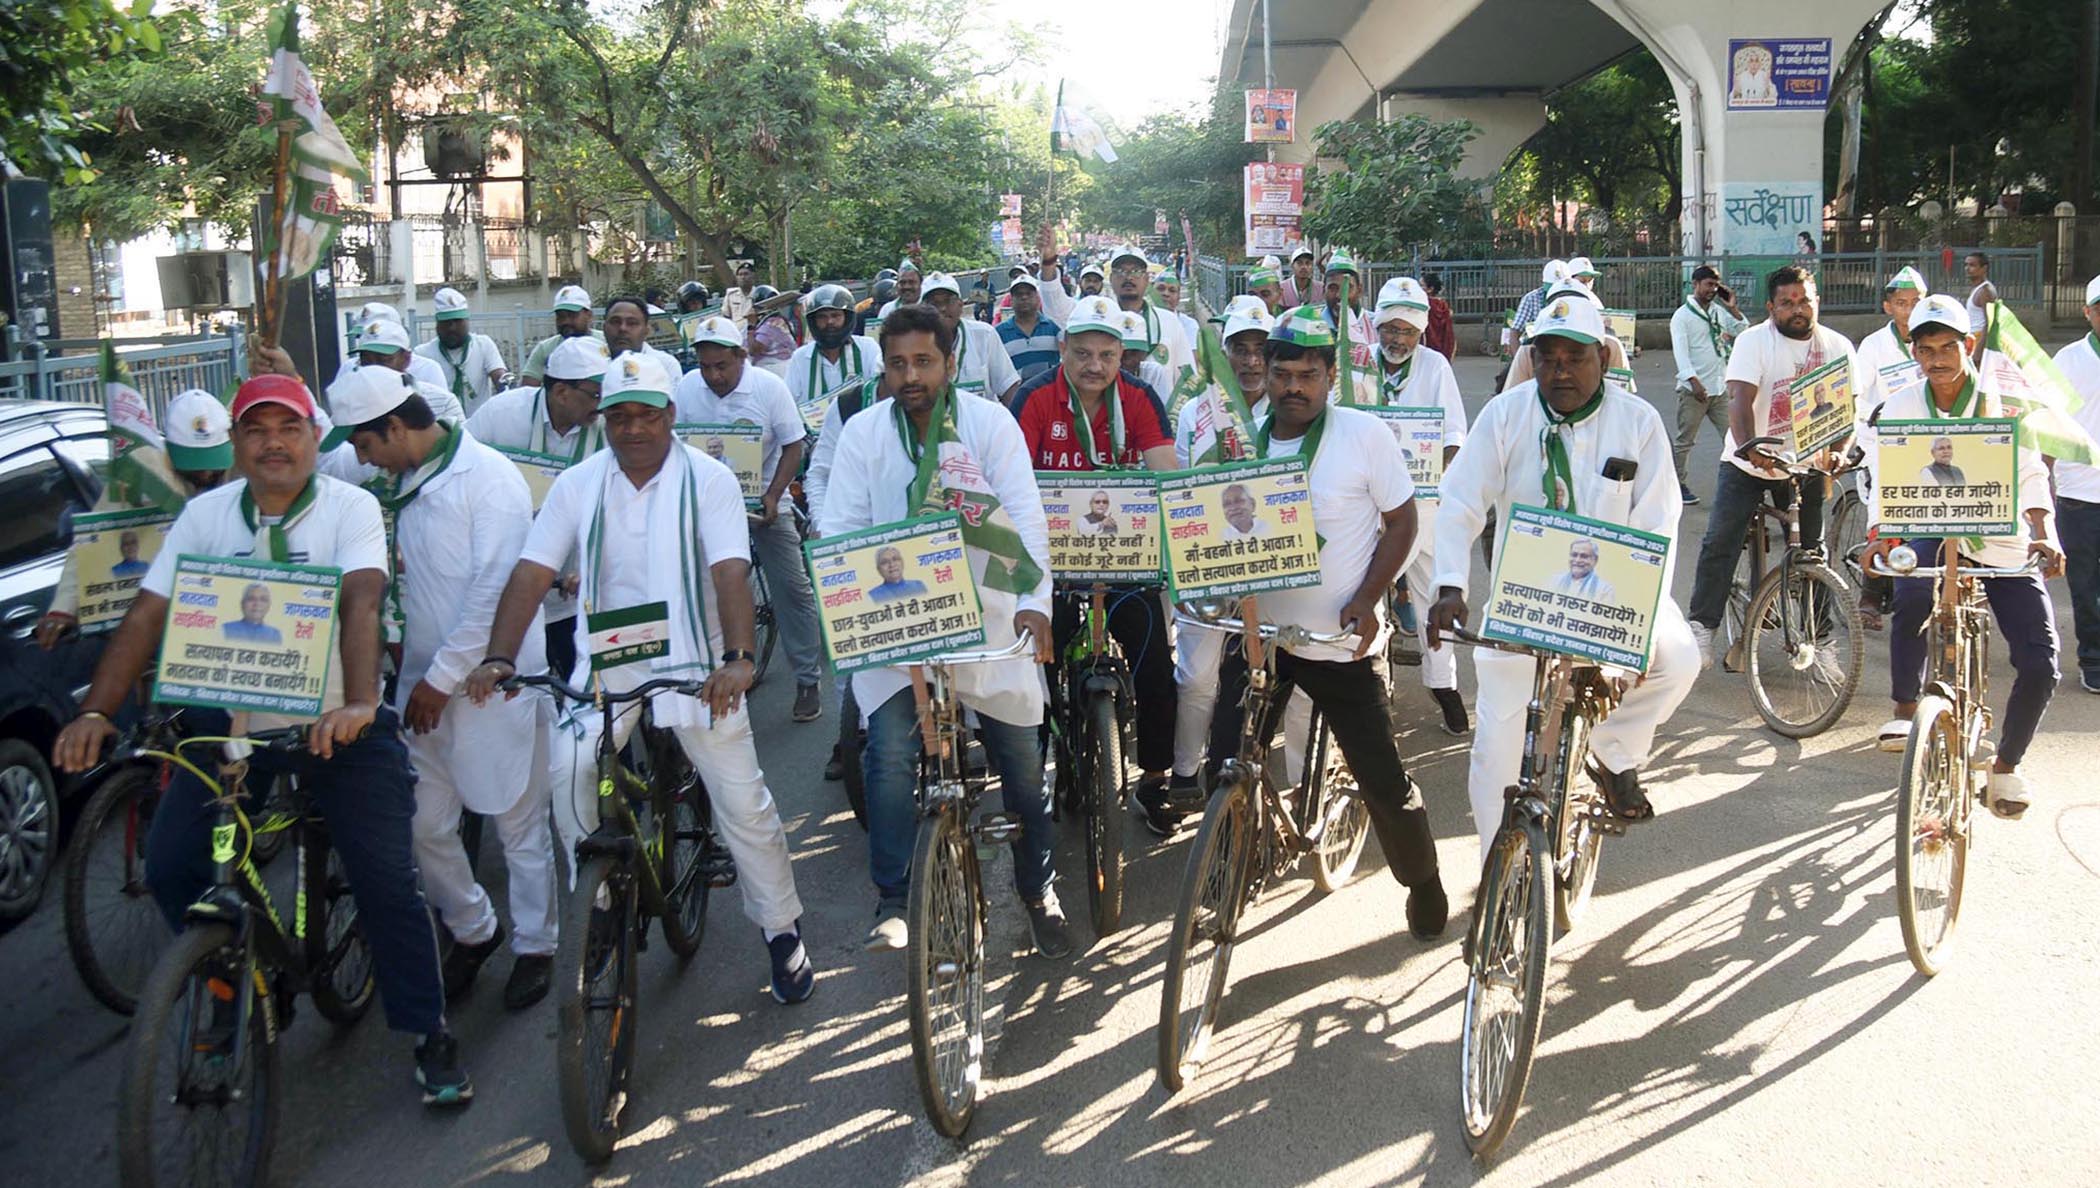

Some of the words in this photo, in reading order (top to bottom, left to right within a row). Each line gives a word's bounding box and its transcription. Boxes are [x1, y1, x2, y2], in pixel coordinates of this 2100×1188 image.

[1725, 189, 1813, 230] सर्वेक्षण
[1043, 448, 1133, 468] HACET
[1881, 486, 1897, 498] हर
[1901, 486, 1918, 498] घर
[1921, 485, 1941, 498] तक
[1945, 485, 1964, 498] हम
[1967, 481, 2001, 497] जायेंगे
[1169, 504, 1204, 519] मतदाता
[1279, 506, 1297, 523] रैली
[1883, 505, 1928, 518] मतदाता
[1931, 501, 1947, 517] को
[1950, 501, 1993, 517] जगायेंगे
[1131, 516, 1146, 529] रैली
[1170, 521, 1208, 539] साइकिल
[1071, 534, 1095, 547] कोई
[1098, 535, 1116, 551] छूटे
[1119, 533, 1145, 547] नहीं
[1184, 540, 1232, 561] माँ-बहनों
[1233, 539, 1244, 555] ने
[1246, 536, 1258, 553] दी
[1261, 535, 1294, 551] आवाज
[1068, 552, 1092, 566] कोई
[1117, 552, 1142, 565] नहीं
[933, 565, 953, 583] रैली
[1176, 565, 1200, 583] चलो
[1201, 563, 1245, 580] सत्यापन
[1247, 554, 1278, 573] करायें
[1280, 555, 1303, 569] आज
[820, 570, 855, 586] मतदाता
[179, 592, 217, 605] मतदाता
[822, 588, 862, 607] साइकिल
[1502, 581, 1553, 603] सत्यापन
[1591, 602, 1636, 624] करायेंगे
[832, 604, 892, 632] छात्र-युवाओं
[894, 602, 905, 617] ने
[907, 598, 919, 615] दी
[922, 594, 956, 612] आवाज
[1495, 599, 1527, 618] औरों
[1527, 607, 1544, 623] को
[1546, 611, 1564, 628] भी
[1567, 618, 1627, 643] समझायेंगे
[833, 635, 857, 653] चलो
[859, 628, 904, 647] सत्यापन
[905, 617, 937, 637] करायें
[940, 615, 963, 630] आज
[1522, 628, 1544, 641] बिहार
[185, 643, 233, 660] सत्यापन
[237, 649, 256, 663] हम
[166, 663, 209, 679] मतदान
[211, 664, 228, 682] को
